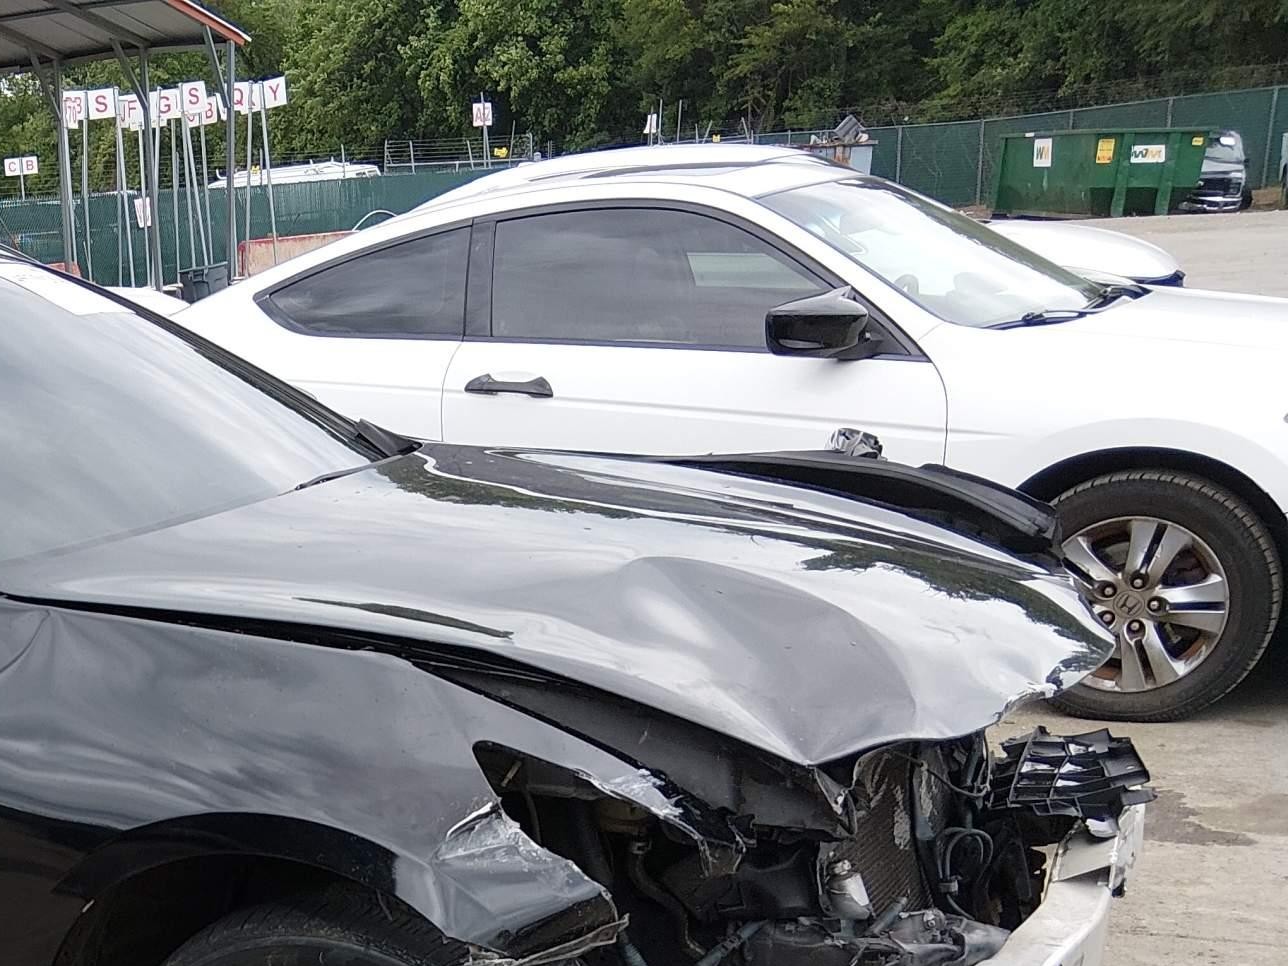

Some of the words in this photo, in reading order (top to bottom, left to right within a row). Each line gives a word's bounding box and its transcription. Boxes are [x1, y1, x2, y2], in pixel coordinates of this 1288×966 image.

[188, 87, 200, 105] S
[268, 83, 280, 101] Y
[95, 95, 108, 113] S
[8, 161, 17, 172] C
[25, 160, 35, 171] B
